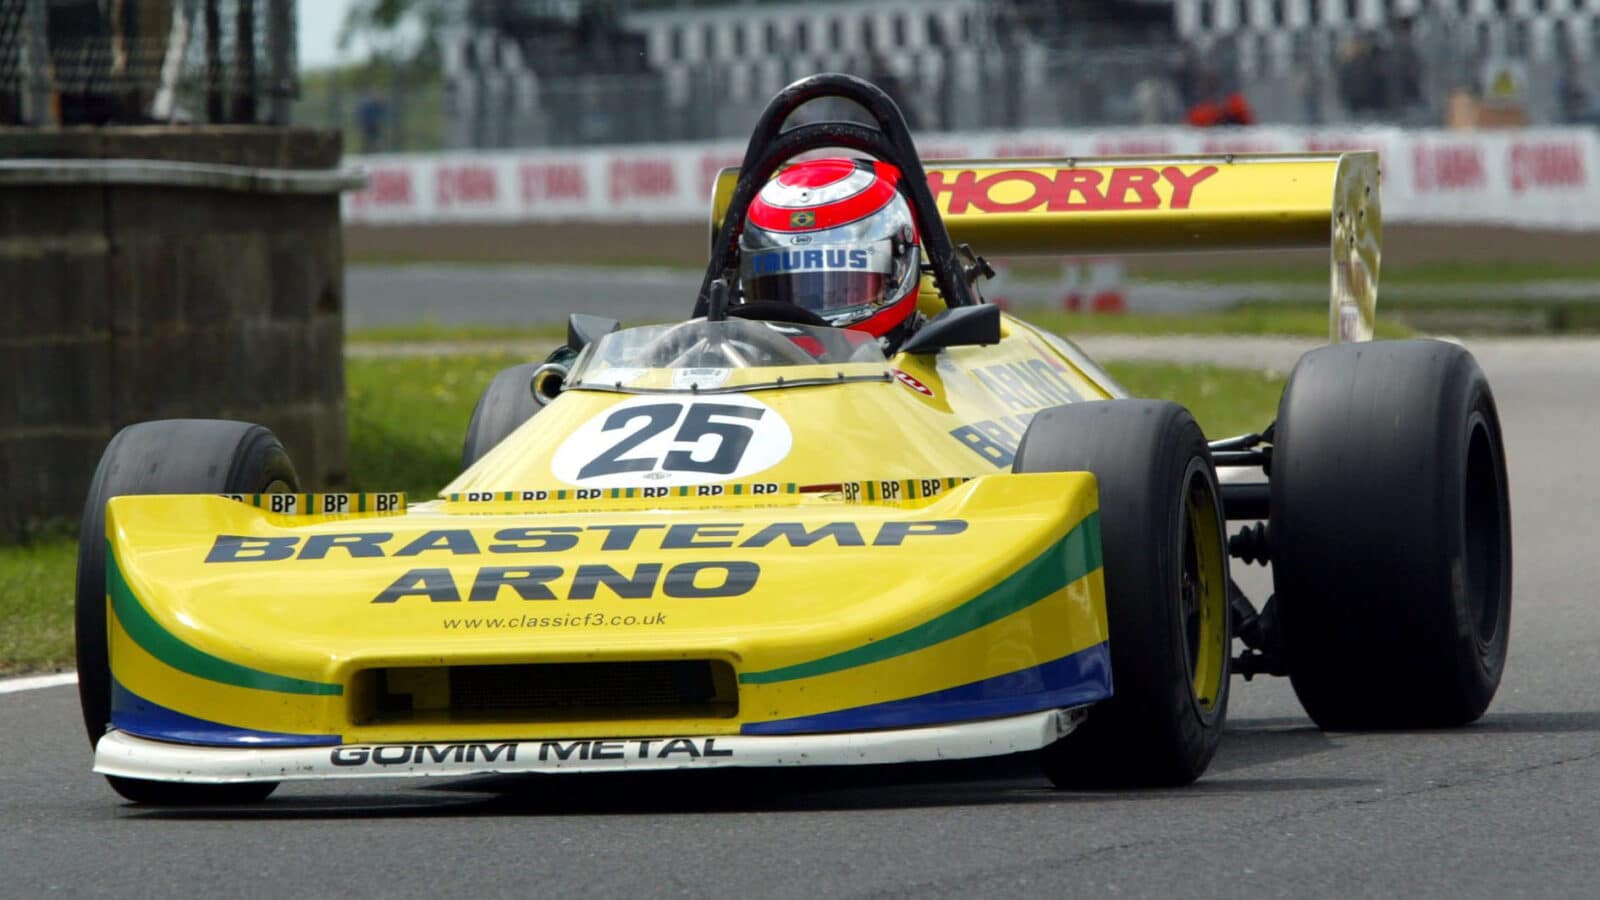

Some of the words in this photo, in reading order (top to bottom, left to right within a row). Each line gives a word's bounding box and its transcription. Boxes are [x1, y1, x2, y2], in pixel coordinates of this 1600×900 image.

[926, 166, 1218, 215] HOBBY
[753, 249, 867, 274] TAURUS
[576, 402, 766, 480] 25
[271, 495, 296, 512] BP
[324, 494, 348, 512] BP
[376, 494, 398, 511] BP
[844, 482, 860, 500] BP
[881, 481, 900, 499] BP
[921, 479, 941, 497] BP
[204, 519, 968, 563] BRASTEMP
[370, 561, 760, 604] ARNO
[443, 611, 667, 629] www.classicf3.co.uk
[330, 742, 519, 767] GOMM
[538, 738, 733, 761] METAL
